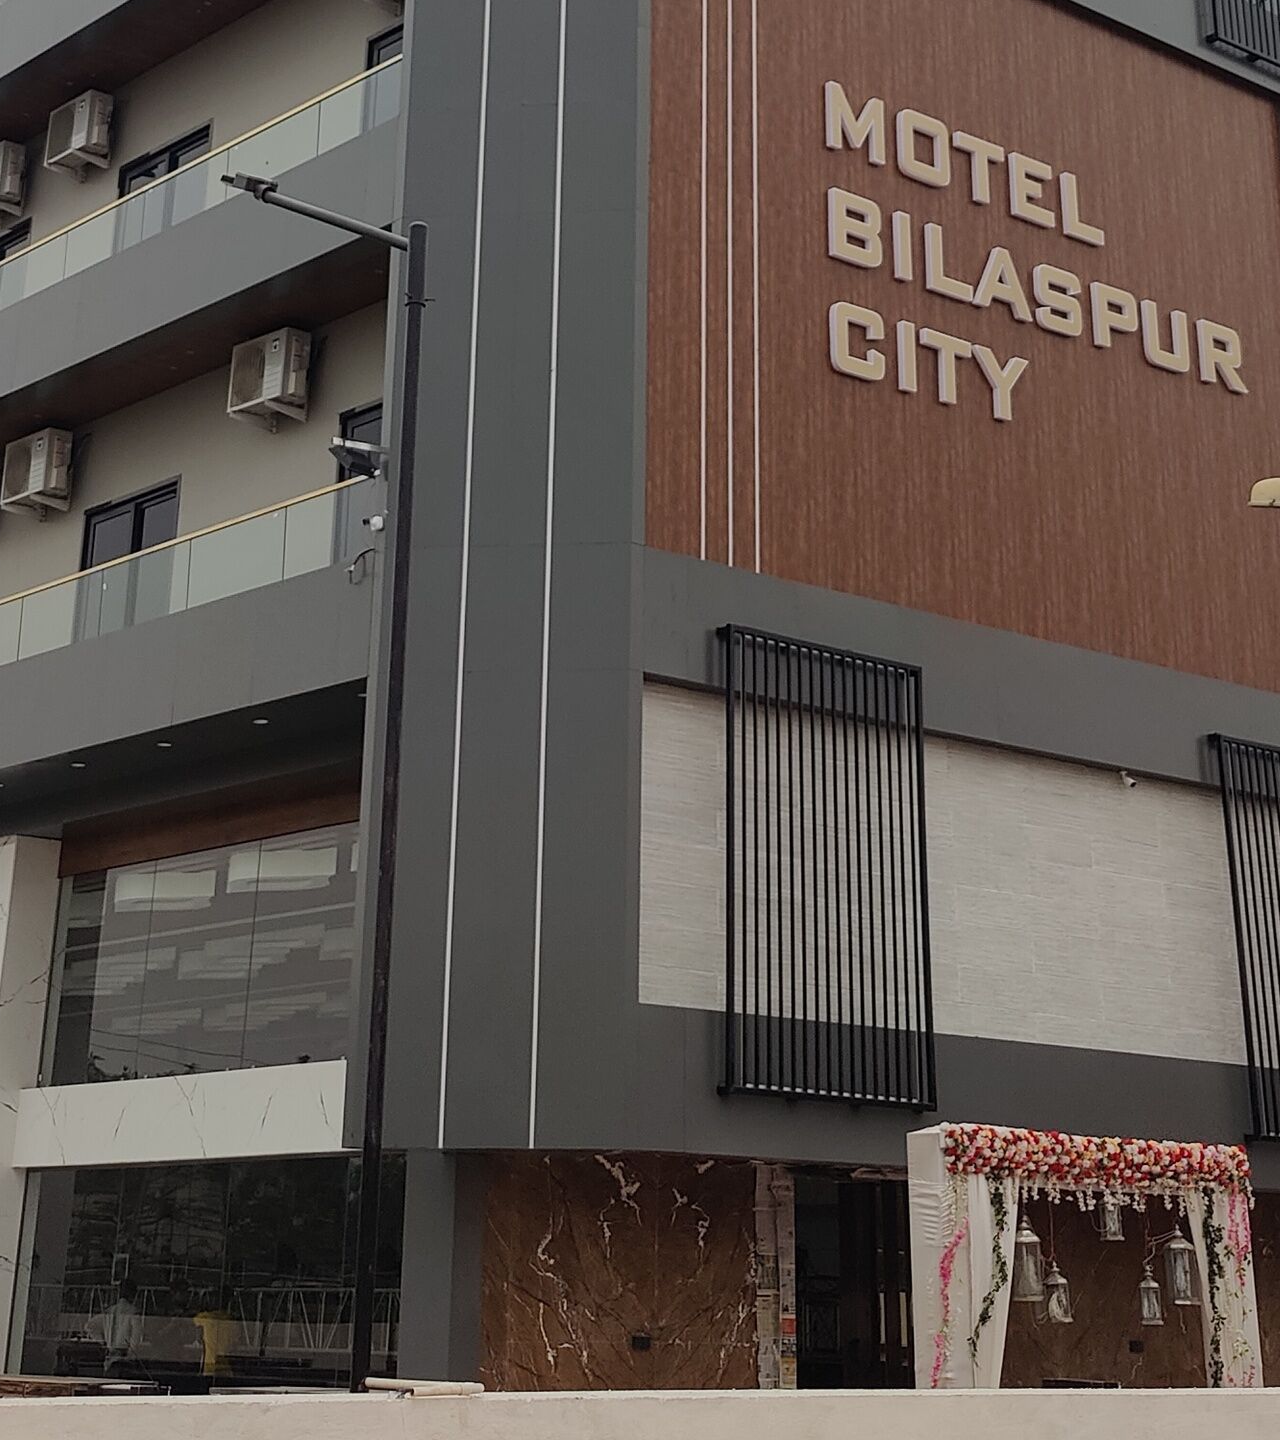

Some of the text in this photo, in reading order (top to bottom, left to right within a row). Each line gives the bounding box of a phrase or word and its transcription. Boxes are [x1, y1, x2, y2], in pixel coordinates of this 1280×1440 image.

[825, 81, 1105, 247] MOTEL
[828, 186, 1249, 394] BILASPUR
[829, 301, 1029, 421] CITY
